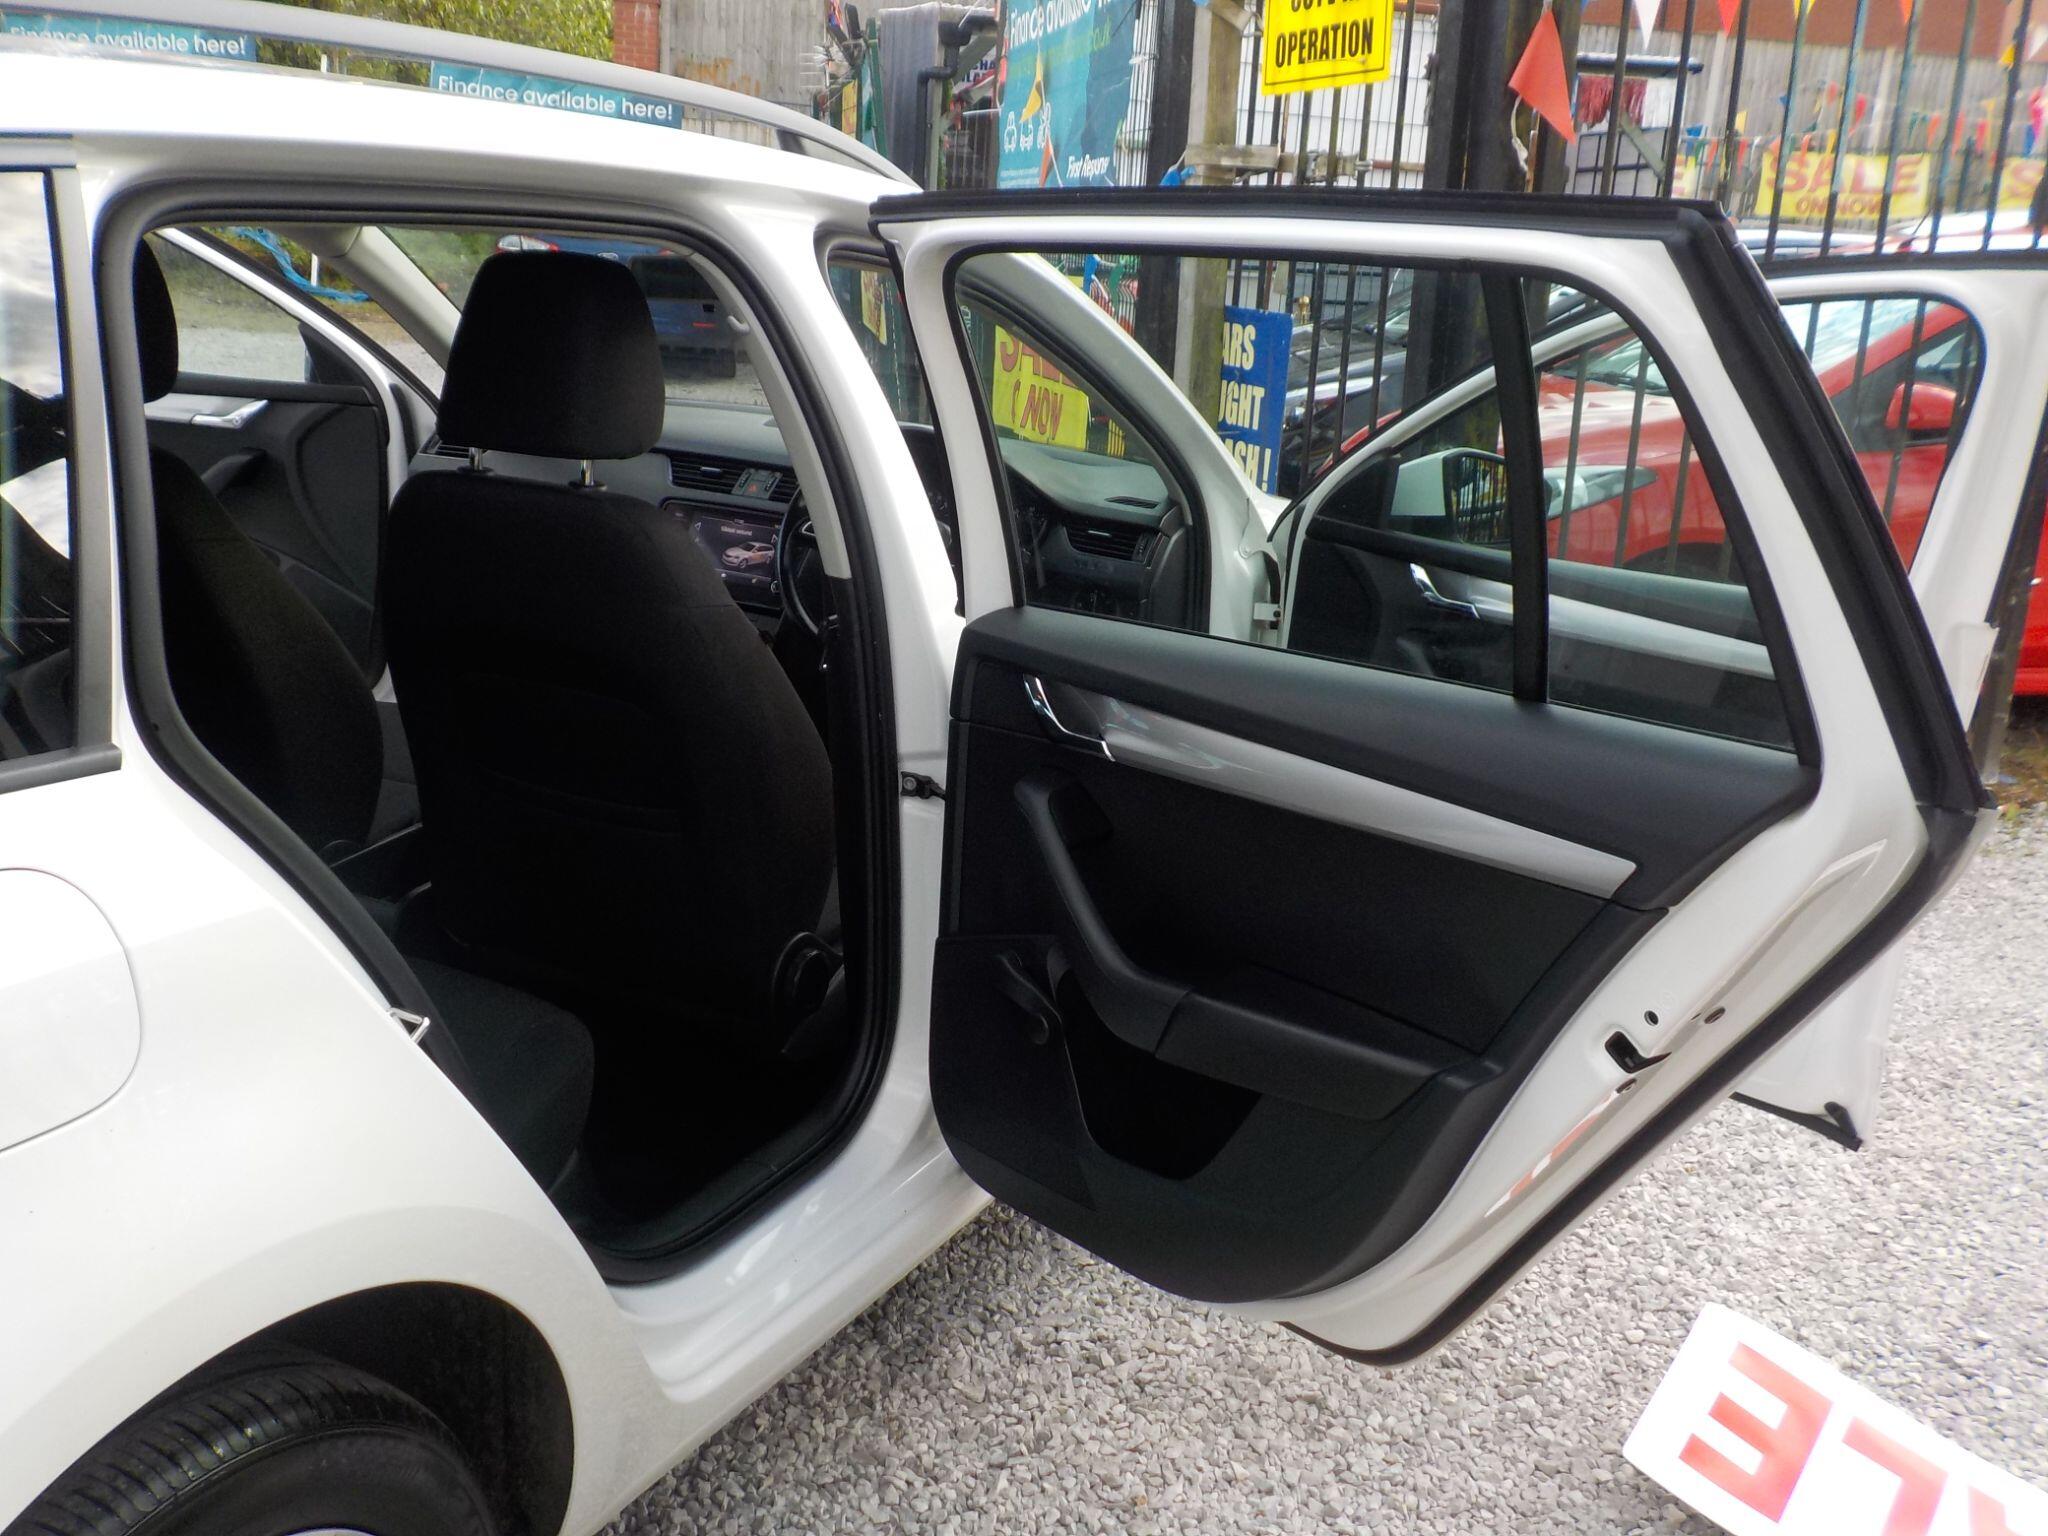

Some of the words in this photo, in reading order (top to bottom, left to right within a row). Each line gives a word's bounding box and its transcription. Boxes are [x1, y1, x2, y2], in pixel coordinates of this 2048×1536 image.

[95, 31, 188, 51] available
[194, 33, 248, 55] here!
[1010, 9, 1044, 49] Finance
[1046, 0, 1091, 33] availa
[1275, 17, 1374, 68] OPERATION
[438, 75, 516, 101] Finance
[522, 90, 616, 113] available
[621, 96, 673, 120] here!
[1767, 153, 1922, 194] SALE
